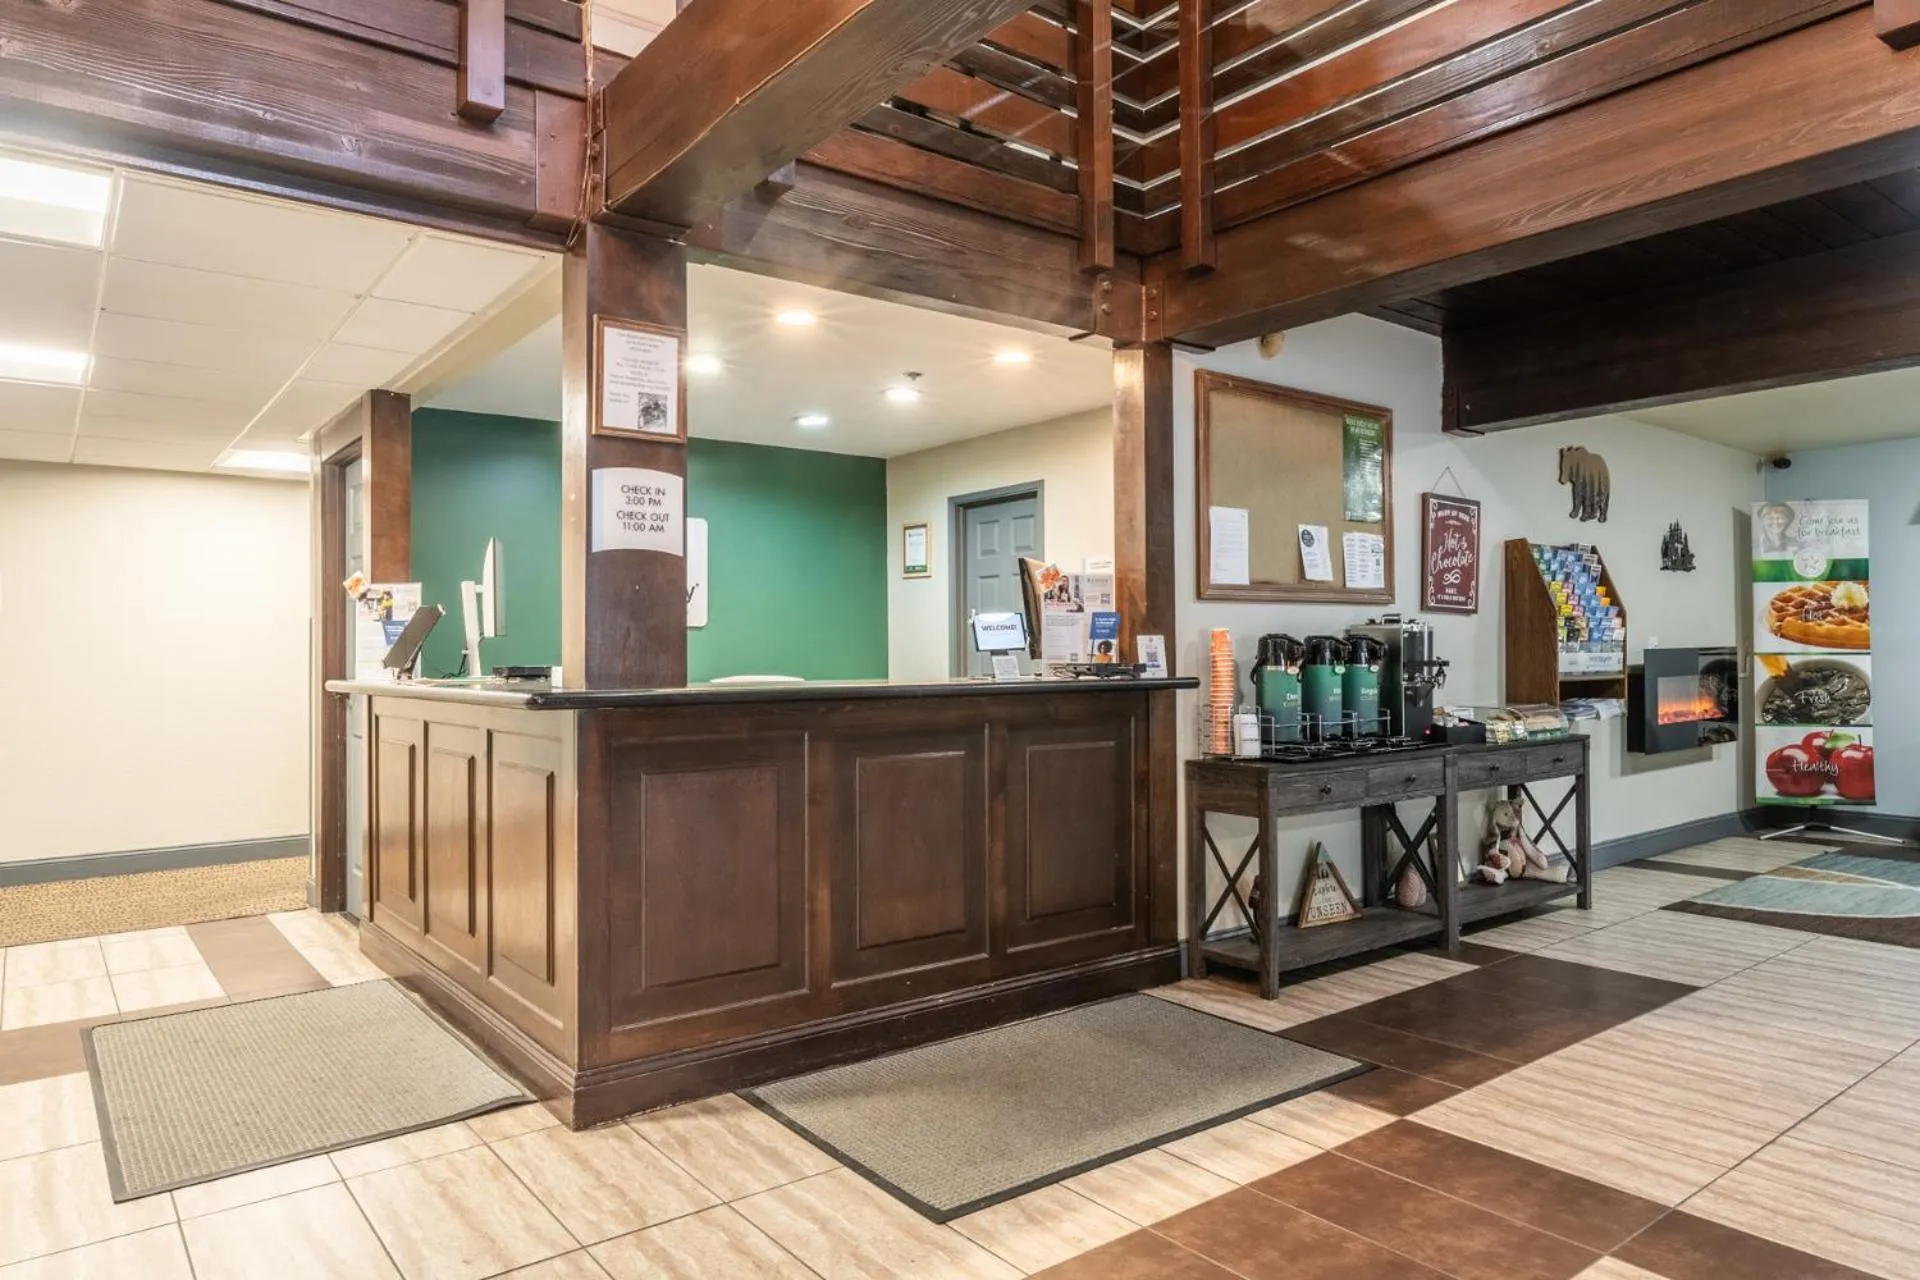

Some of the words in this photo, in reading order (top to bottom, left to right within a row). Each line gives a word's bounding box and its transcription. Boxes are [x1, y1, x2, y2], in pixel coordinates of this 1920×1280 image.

[620, 484, 652, 496] CHECK
[654, 487, 666, 497] IN
[648, 497, 662, 507] PM
[616, 510, 648, 521] CHECK
[650, 512, 669, 522] OUT
[1798, 515, 1824, 525] Come
[623, 522, 646, 532] 11:00
[648, 523, 665, 533] AM
[1797, 526, 1811, 539] for
[1814, 526, 1860, 539] breakfast
[1442, 528, 1462, 553] Hot
[1431, 546, 1473, 575] Chocolate
[981, 623, 1017, 632] WELCOME!
[1794, 691, 1832, 705] Fresh
[1792, 759, 1839, 777] Healthy
[1310, 901, 1346, 918] UNSEEN
